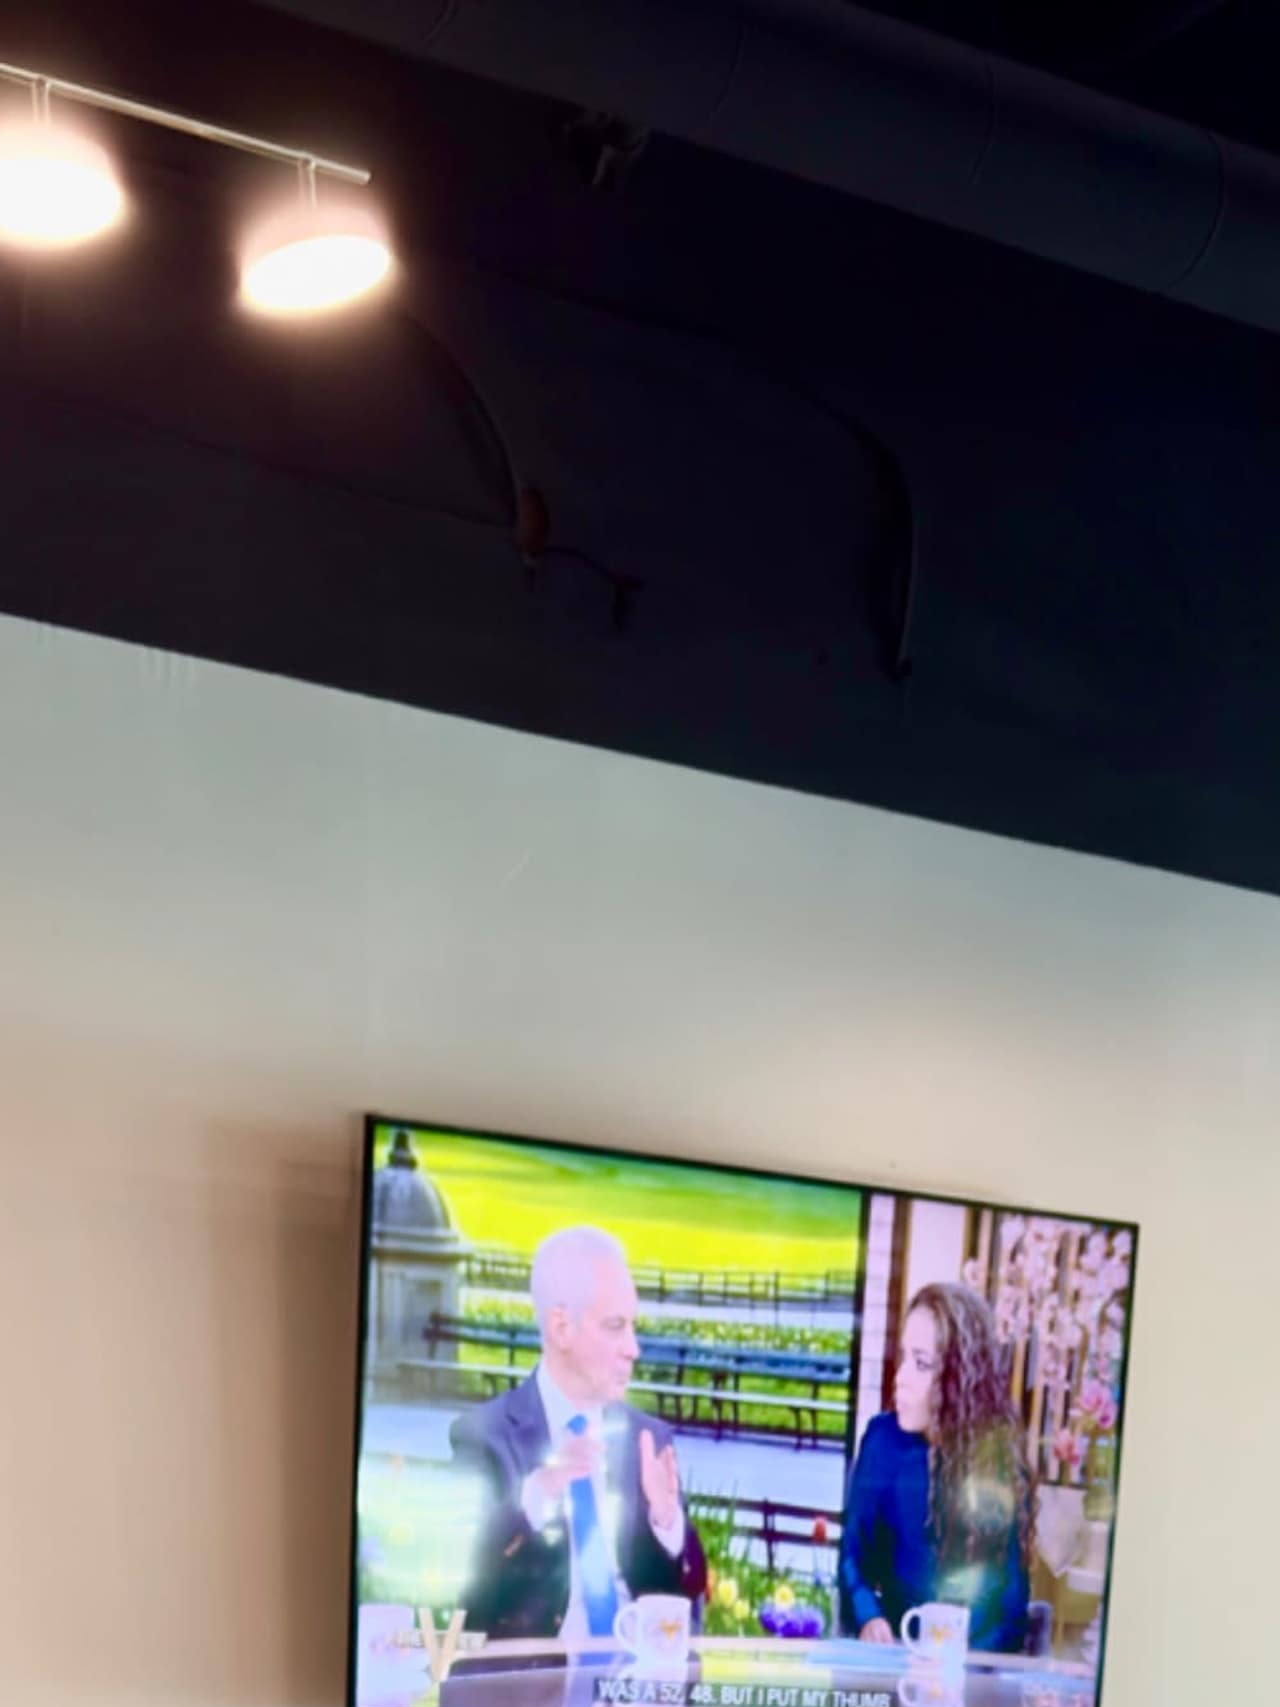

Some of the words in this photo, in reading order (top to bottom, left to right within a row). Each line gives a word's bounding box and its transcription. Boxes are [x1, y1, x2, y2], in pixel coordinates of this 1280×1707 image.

[598, 1680, 638, 1701] WAS
[643, 1682, 657, 1701] A
[721, 1685, 753, 1706] BUT
[768, 1687, 798, 1707] PUT
